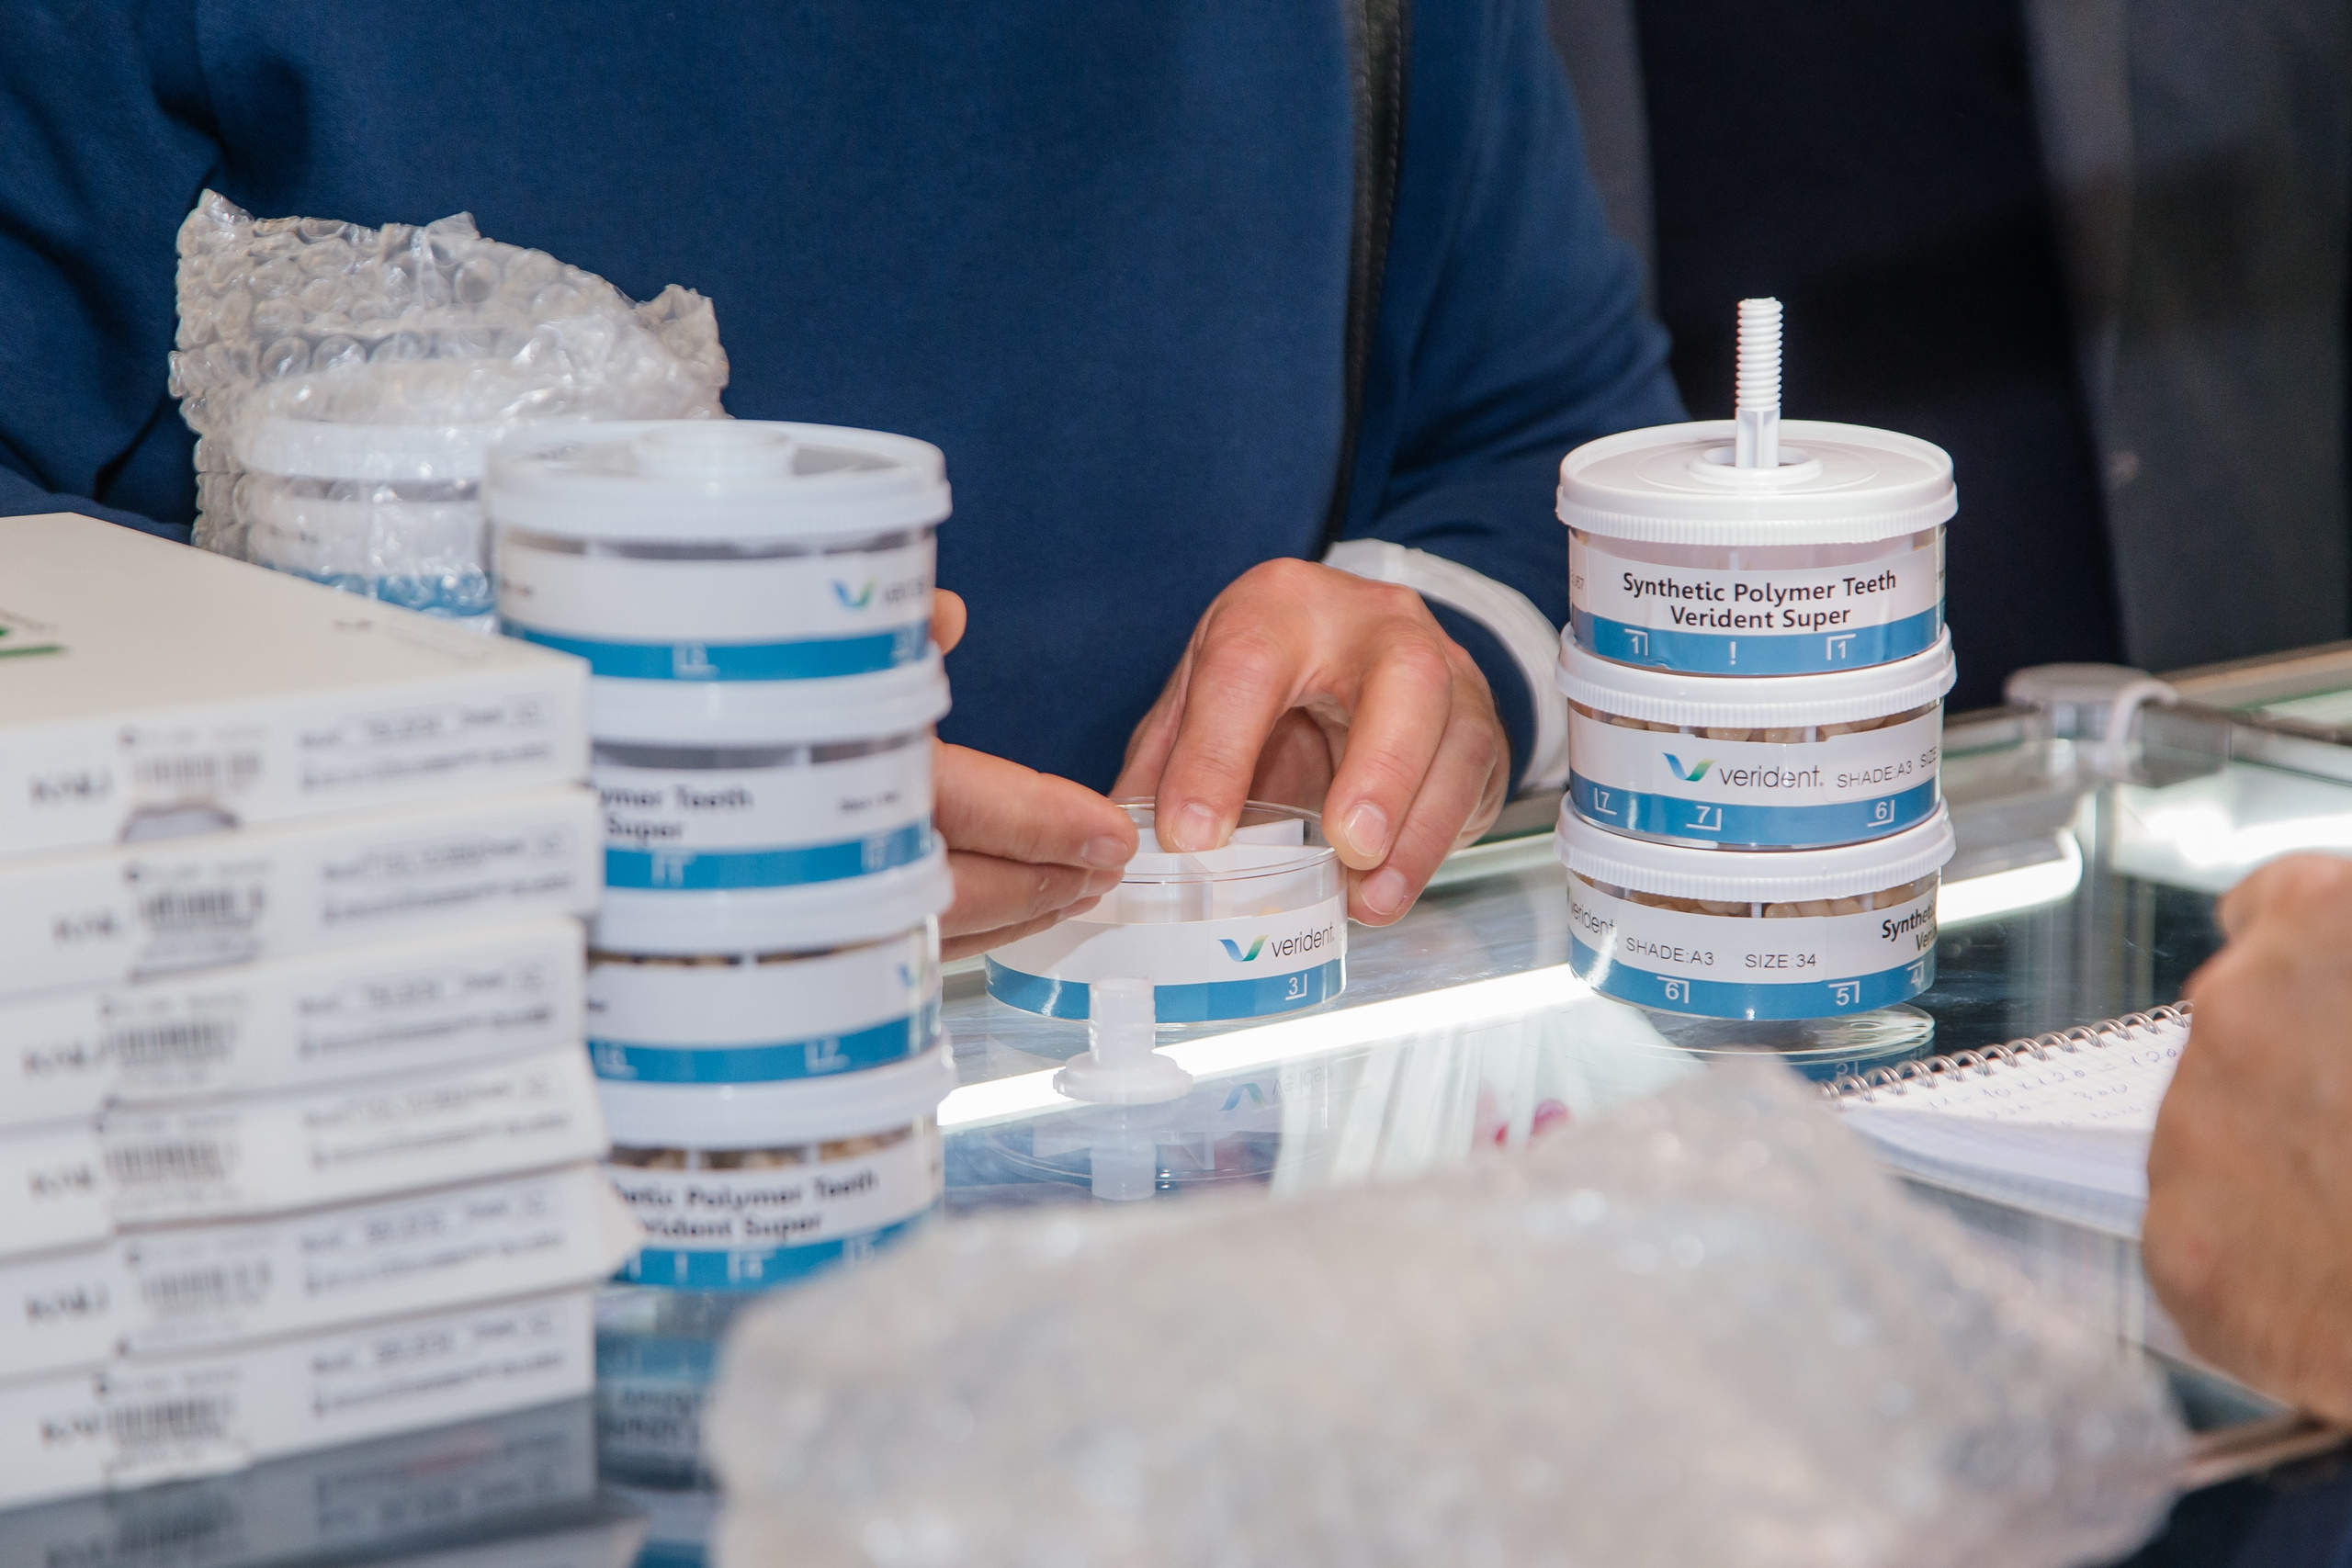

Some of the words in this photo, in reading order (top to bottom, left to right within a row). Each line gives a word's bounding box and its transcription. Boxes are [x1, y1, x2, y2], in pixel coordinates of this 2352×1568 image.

[1623, 572, 1725, 602] Synthetic
[1735, 582, 1836, 608] Polymer
[1843, 570, 1896, 597] Teeth
[1670, 605, 1774, 628] Verident
[1782, 609, 1851, 632] Super
[1837, 761, 1913, 788] SHADE:A3
[1626, 937, 1715, 966] SHADE:A3
[1745, 953, 1817, 969] SIZE:34
